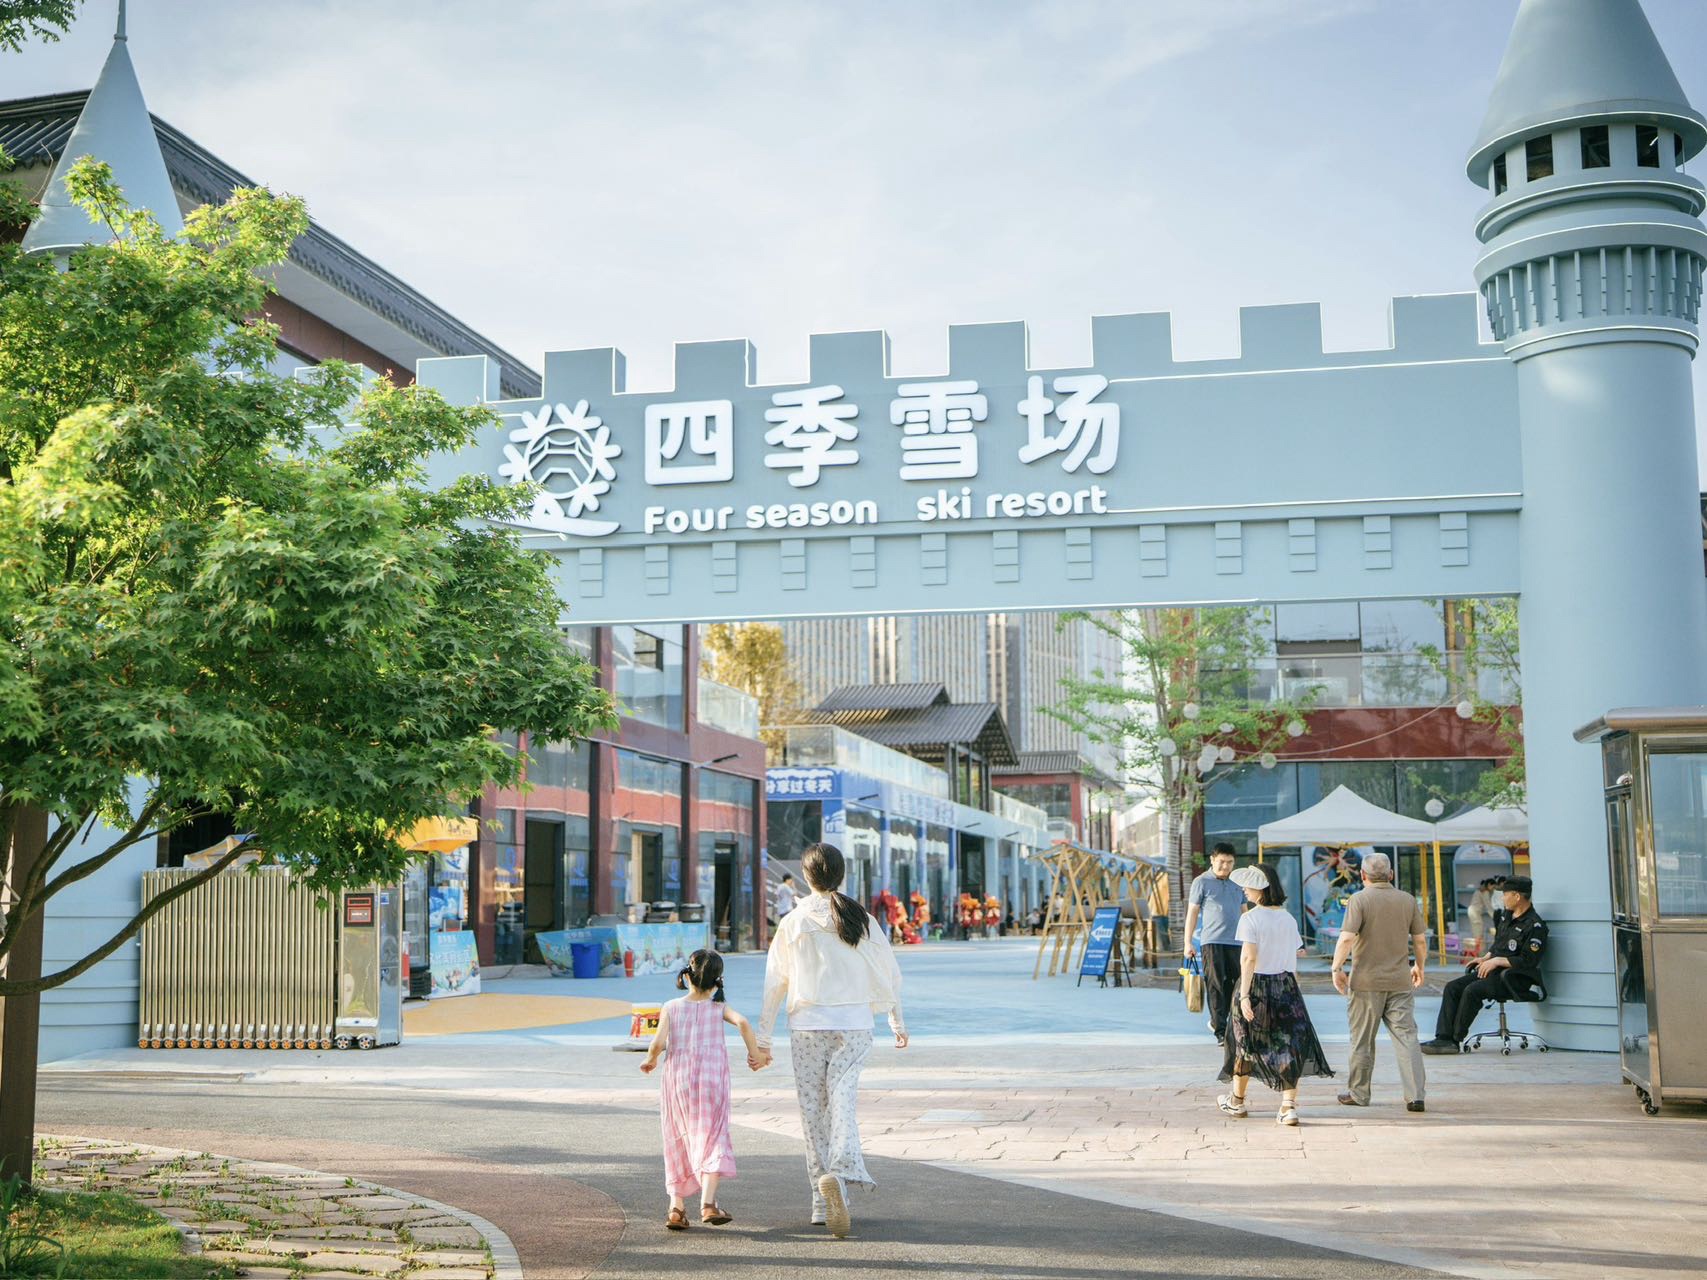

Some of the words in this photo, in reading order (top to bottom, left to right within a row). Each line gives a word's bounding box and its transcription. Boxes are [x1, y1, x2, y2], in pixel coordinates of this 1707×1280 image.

[644, 376, 1121, 487] 四季雪场
[644, 505, 732, 534] Four
[747, 499, 878, 529] season
[917, 487, 971, 520] ski
[986, 485, 1108, 517] resort
